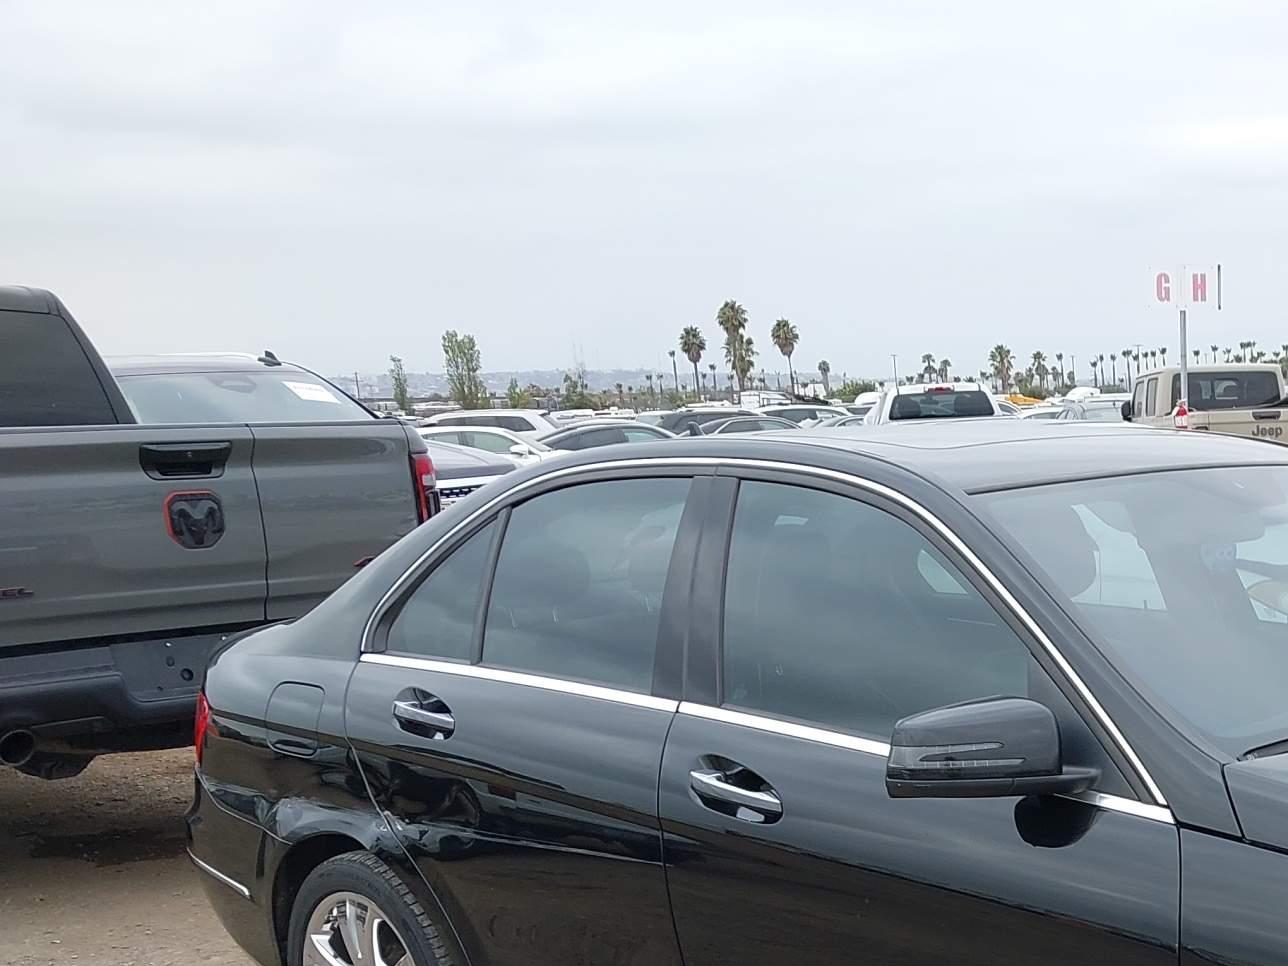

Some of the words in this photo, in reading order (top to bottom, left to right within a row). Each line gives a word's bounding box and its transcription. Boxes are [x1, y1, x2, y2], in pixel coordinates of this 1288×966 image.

[1156, 272, 1171, 302] G
[1192, 272, 1207, 302] H
[1251, 424, 1284, 438] Jeep
